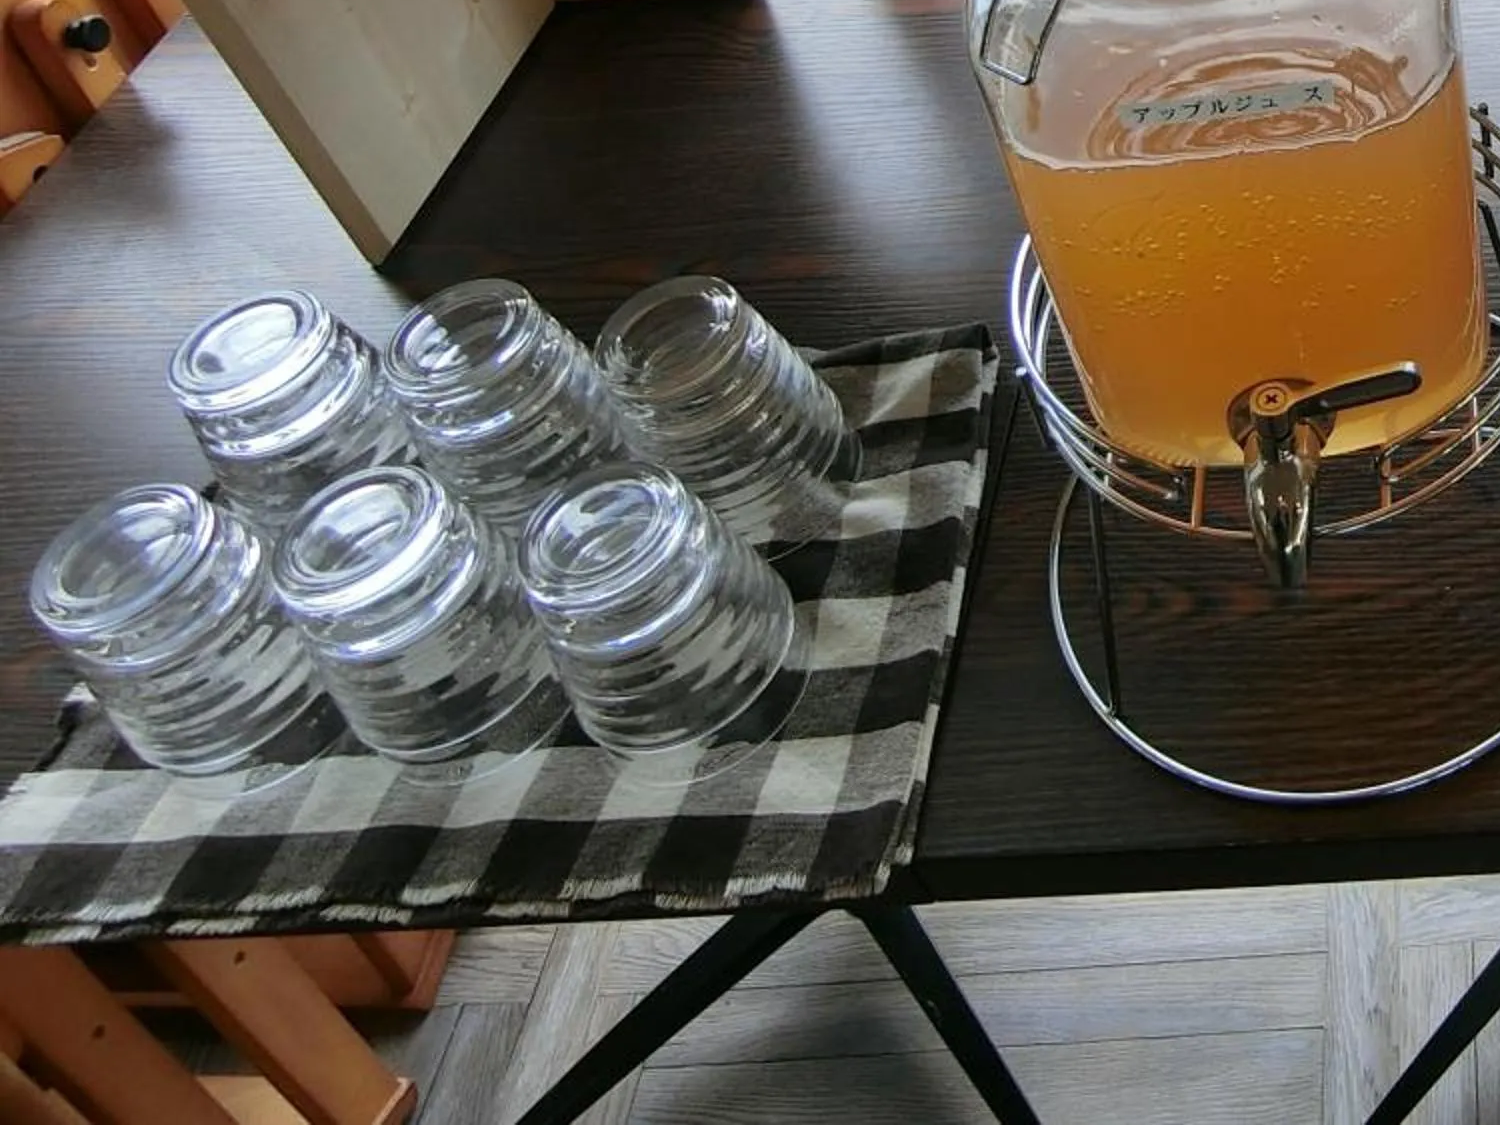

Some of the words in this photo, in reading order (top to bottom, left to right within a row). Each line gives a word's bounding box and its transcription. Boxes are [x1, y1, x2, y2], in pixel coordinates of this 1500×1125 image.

[1131, 85, 1324, 124] アップルジュス
